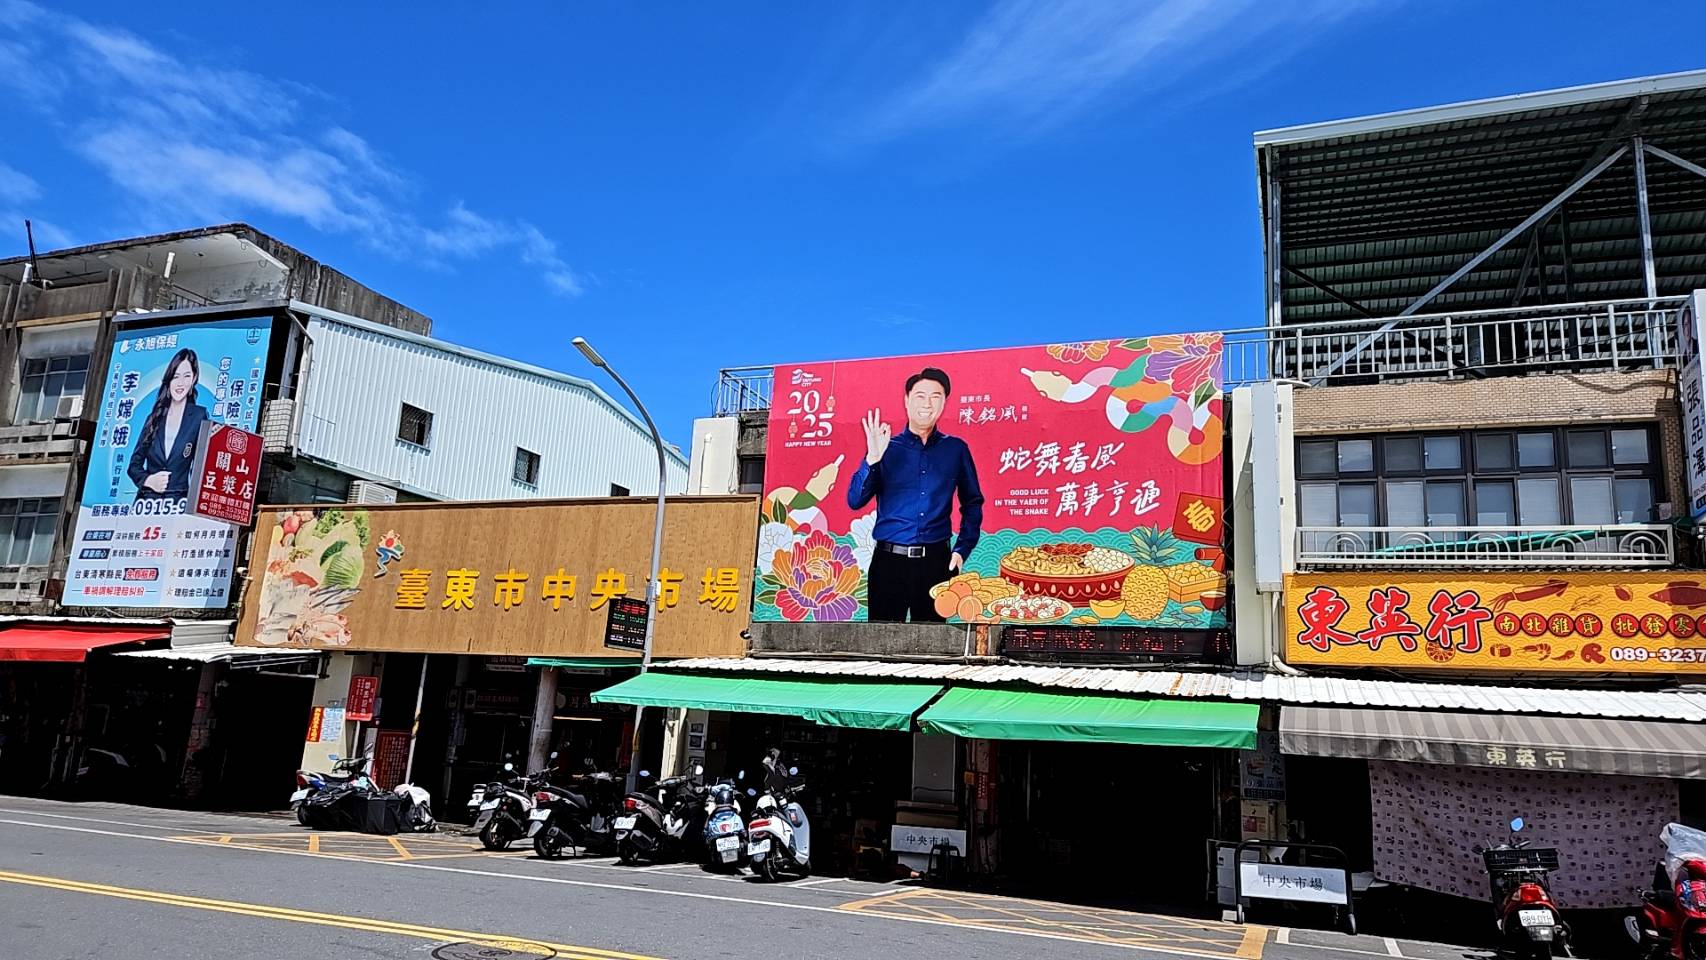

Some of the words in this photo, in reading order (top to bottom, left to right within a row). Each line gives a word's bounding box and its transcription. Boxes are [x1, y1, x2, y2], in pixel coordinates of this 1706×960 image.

[110, 371, 140, 447] 李嫦娥
[786, 390, 820, 414] 20
[801, 412, 834, 438] 25
[817, 439, 832, 447] YEAR
[215, 450, 250, 476] 關山
[998, 440, 1125, 477] 蛇舞春風
[202, 470, 255, 501] 豆漿店
[1030, 488, 1049, 496] LUCK
[1055, 478, 1163, 518] 萬事亨通
[1009, 508, 1024, 516] THE
[1024, 508, 1049, 516] SNAKE
[1182, 499, 1216, 533] 春
[394, 566, 741, 612] 臺東市中央市場
[1298, 586, 1494, 653] 東英行
[1497, 614, 1599, 636] 南北雜貨
[1614, 615, 1706, 637] 批發零
[1485, 745, 1567, 769] 東英行
[905, 833, 951, 846] 中央市場
[1262, 873, 1325, 892] 中央市場
